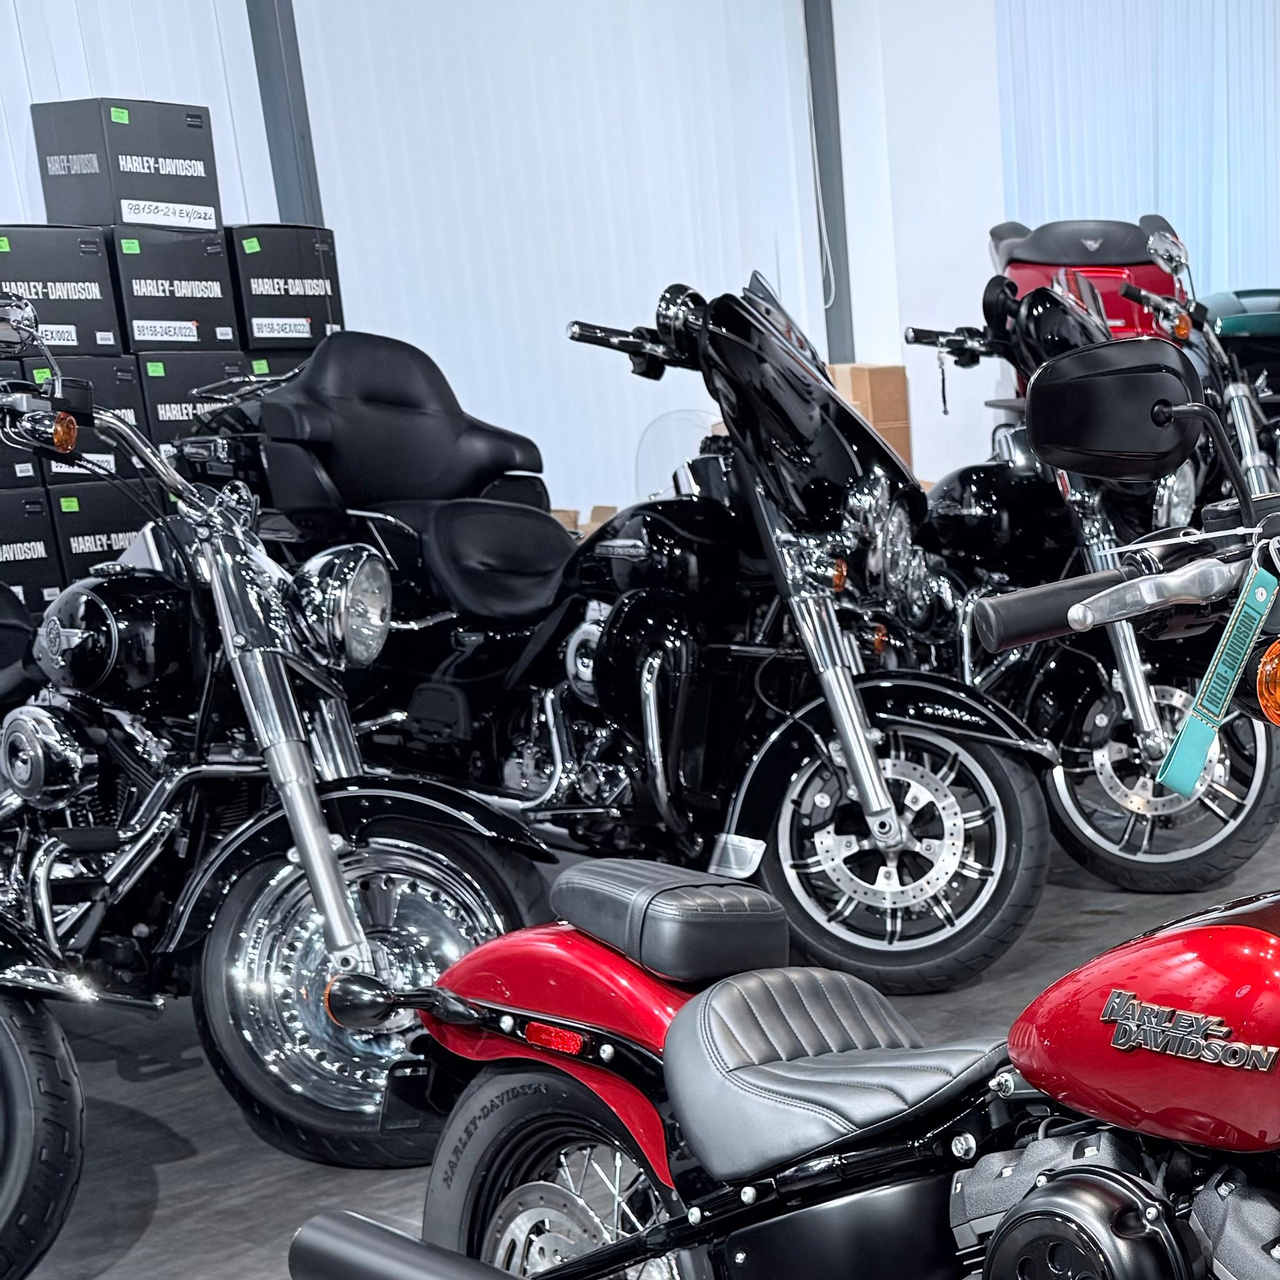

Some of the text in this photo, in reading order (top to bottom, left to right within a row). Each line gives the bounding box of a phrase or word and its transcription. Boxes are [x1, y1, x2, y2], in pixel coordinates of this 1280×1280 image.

[46, 153, 100, 175] HARLEY-DAVIDSON
[118, 154, 207, 177] HARLEY-DAVIDSON
[1, 281, 103, 300] HARLEY-DAVIDSON
[132, 278, 224, 298] HARLEY-DAVIDSON
[250, 278, 333, 296] HARLEY-DAVIDSON
[1205, 611, 1258, 709] HELLO DAVIDSON
[1100, 988, 1233, 1039] HARLEY-
[442, 1082, 549, 1190] HARLEY-DAVIDSON
